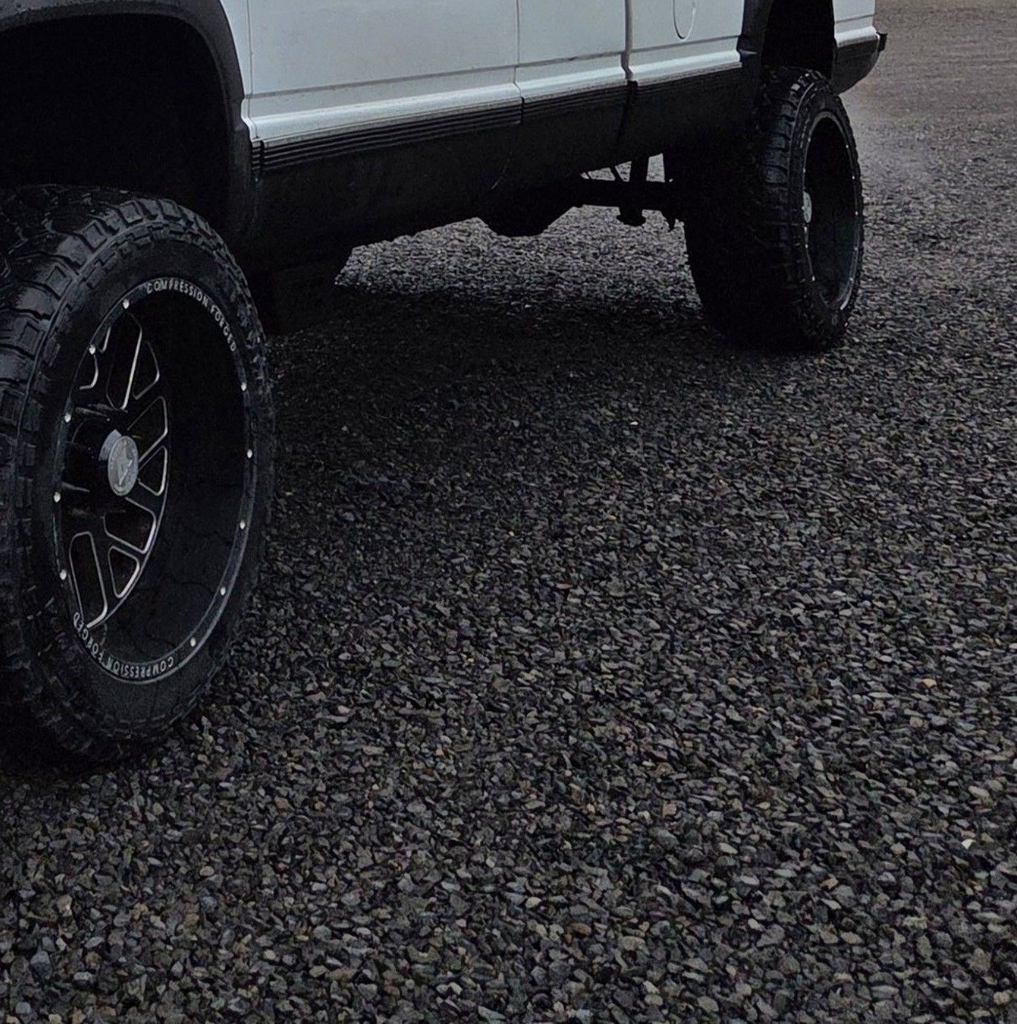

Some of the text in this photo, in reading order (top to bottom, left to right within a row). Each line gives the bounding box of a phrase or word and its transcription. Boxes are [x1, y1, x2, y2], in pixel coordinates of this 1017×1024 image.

[146, 278, 237, 352] COMPRESSION FORGED
[74, 612, 173, 678] COMPRESSION FORGED
